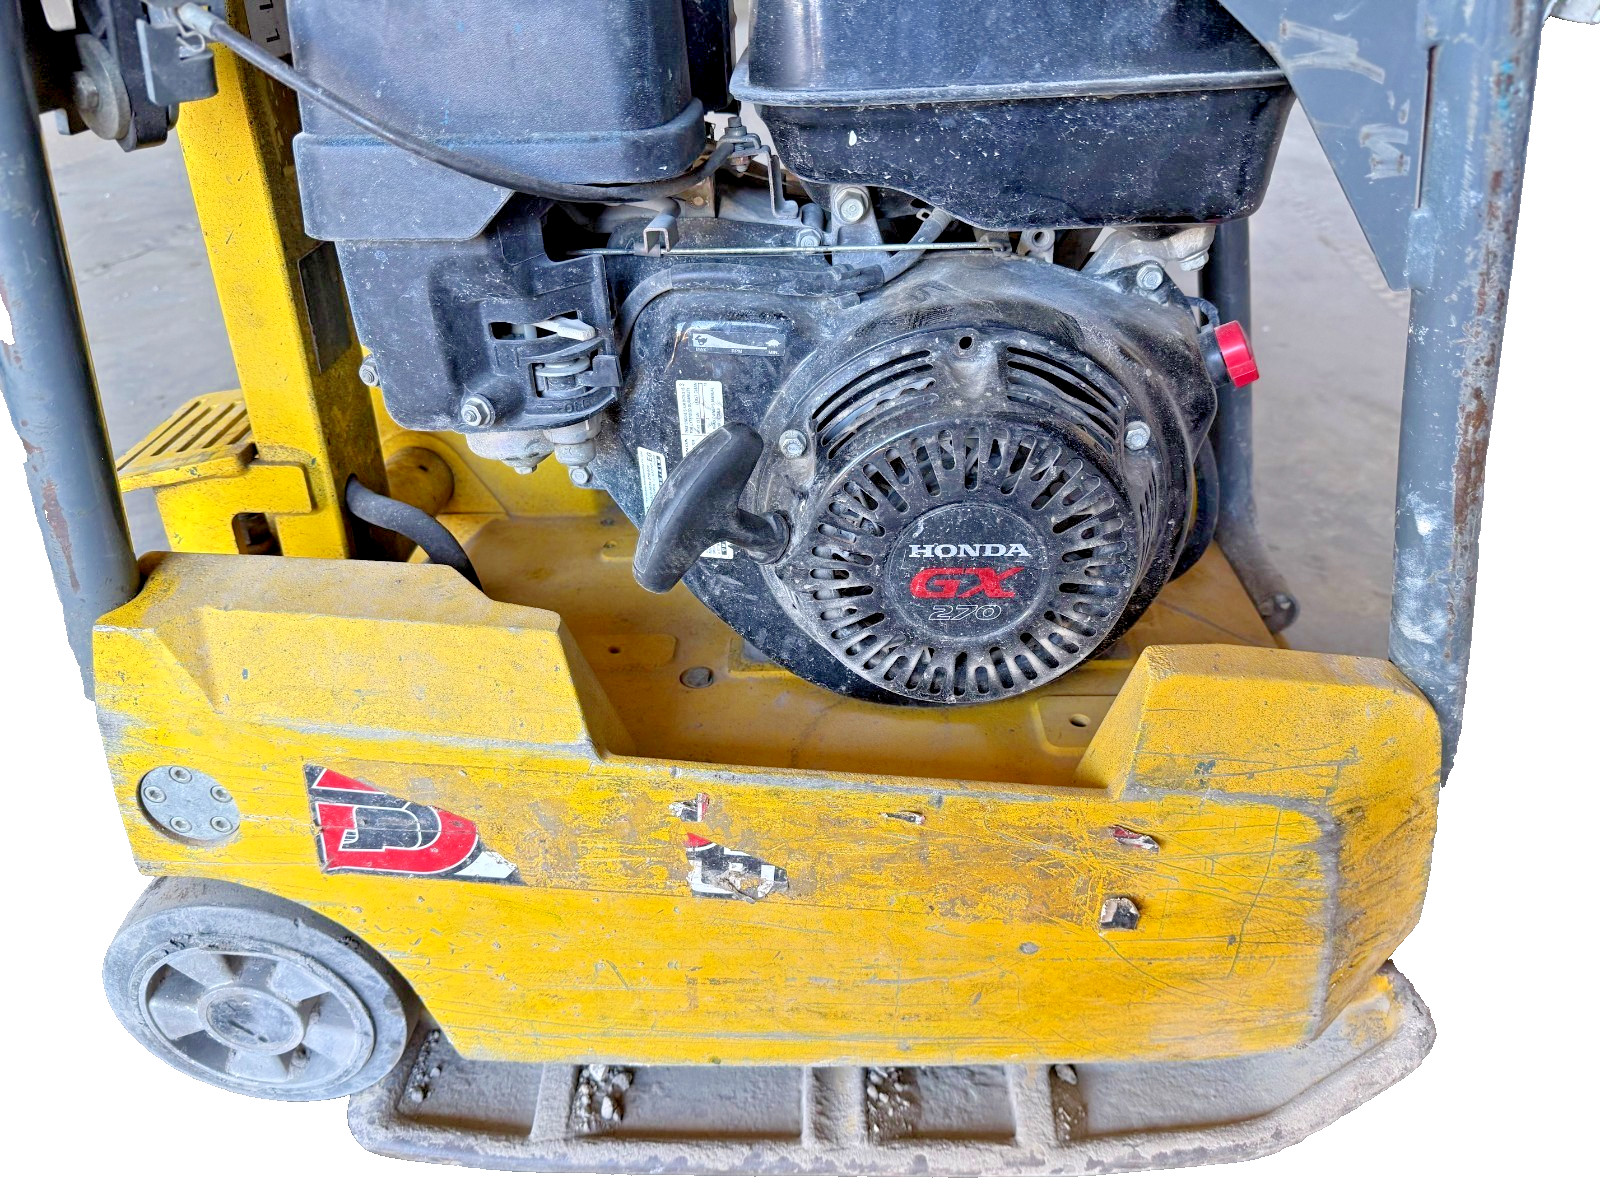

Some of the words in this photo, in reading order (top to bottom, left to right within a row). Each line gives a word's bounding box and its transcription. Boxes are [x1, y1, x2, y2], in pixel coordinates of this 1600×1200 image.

[908, 543, 1031, 558] HONDA
[909, 566, 1025, 599] GX
[928, 604, 1002, 621] 270
